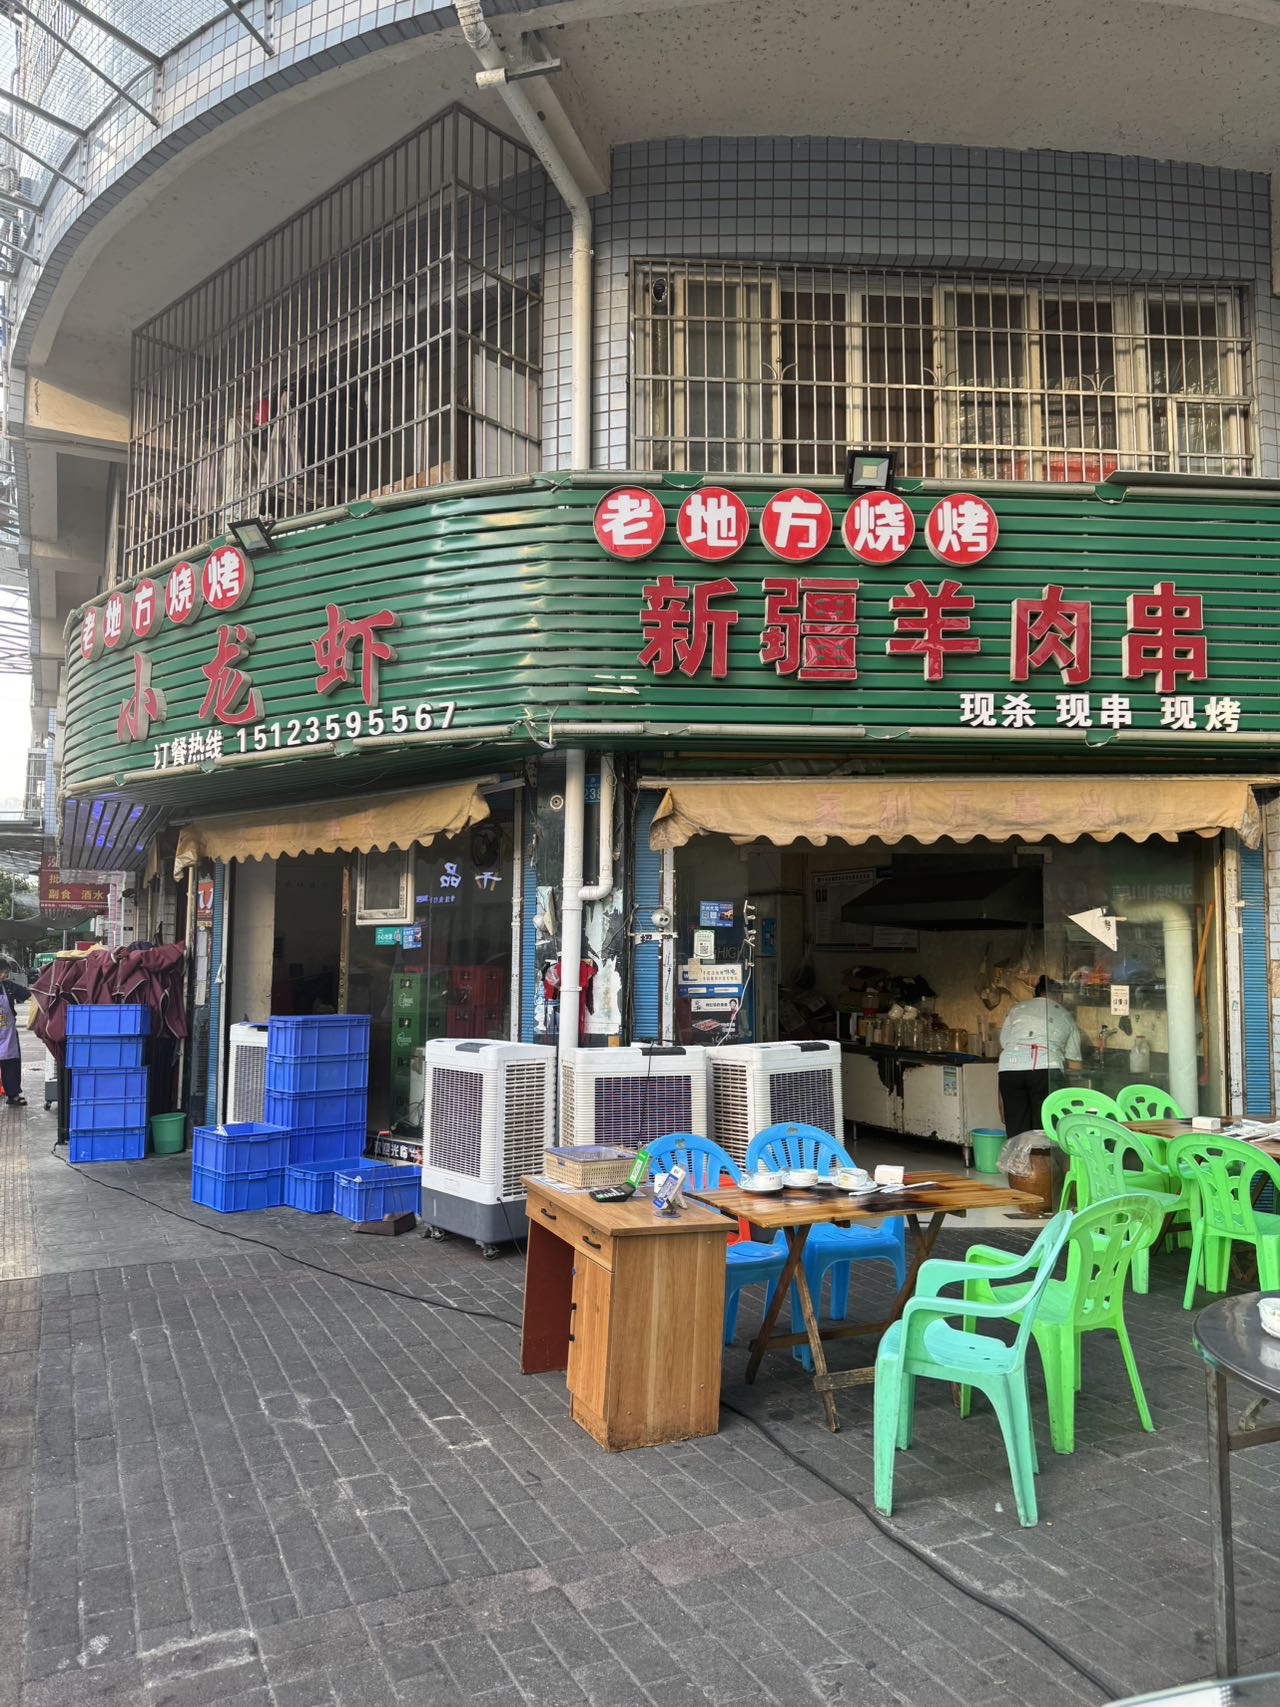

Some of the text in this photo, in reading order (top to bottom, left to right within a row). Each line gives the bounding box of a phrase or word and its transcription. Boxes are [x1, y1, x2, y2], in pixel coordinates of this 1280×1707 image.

[602, 495, 989, 556] 老地方烧烤
[81, 551, 245, 653] 老地方烧烤
[637, 575, 1208, 693] 新疆羊肉串
[116, 602, 402, 743] 小龙虾
[153, 701, 457, 770] 订餐热线 15123595567
[959, 692, 1242, 734] 现杀 现串 现烤
[81, 889, 104, 901] 酒水
